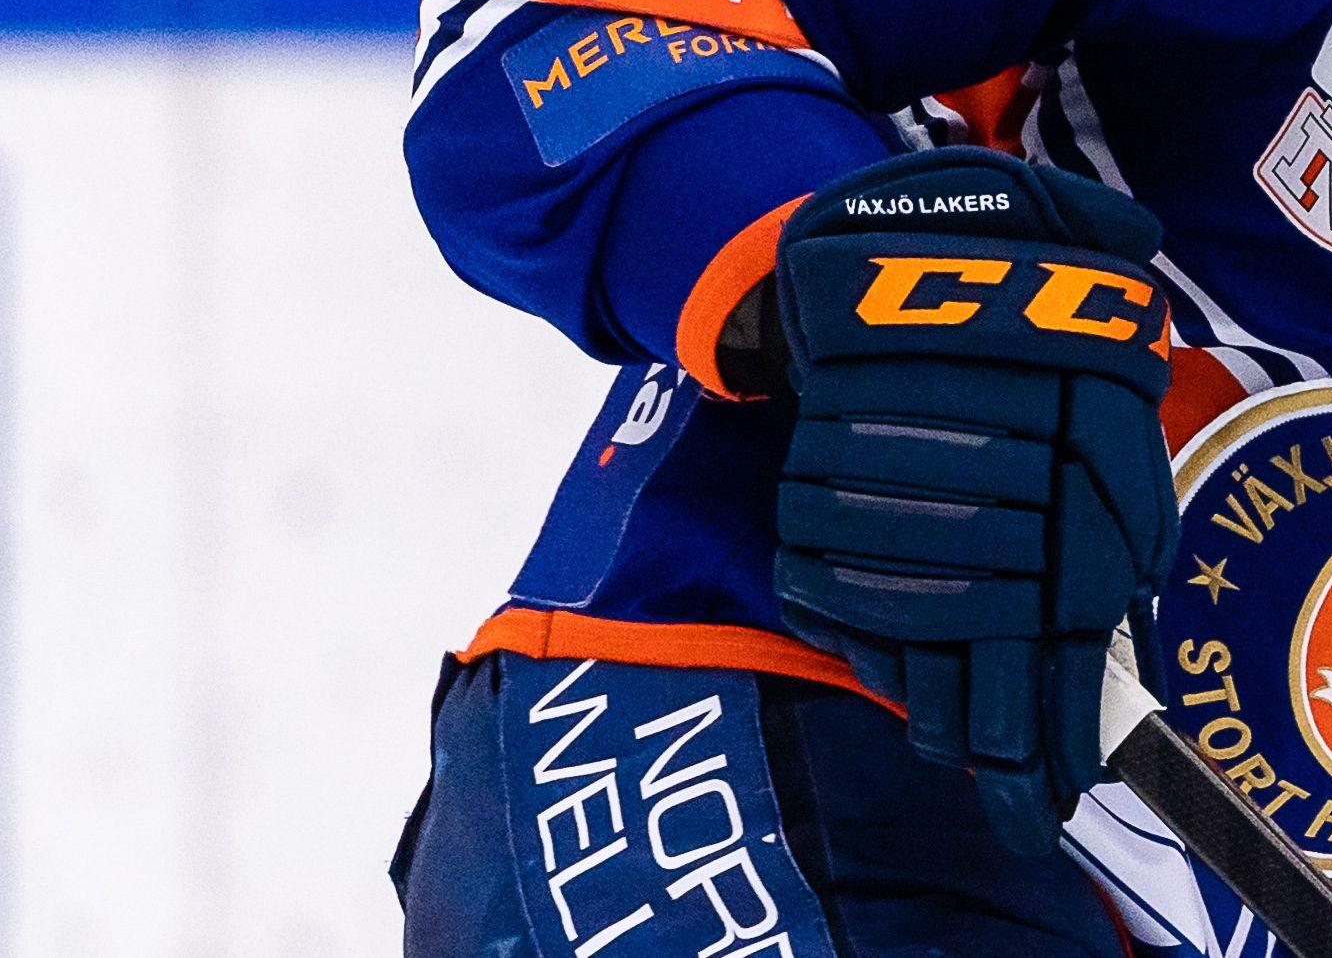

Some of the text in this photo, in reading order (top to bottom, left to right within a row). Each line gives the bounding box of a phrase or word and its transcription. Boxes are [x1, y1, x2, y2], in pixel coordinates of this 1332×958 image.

[845, 193, 1010, 215] VÄXJÖ LAKERS
[855, 257, 1170, 361] CC
[1178, 639, 1310, 818] STORT
[634, 694, 794, 958] NOR
